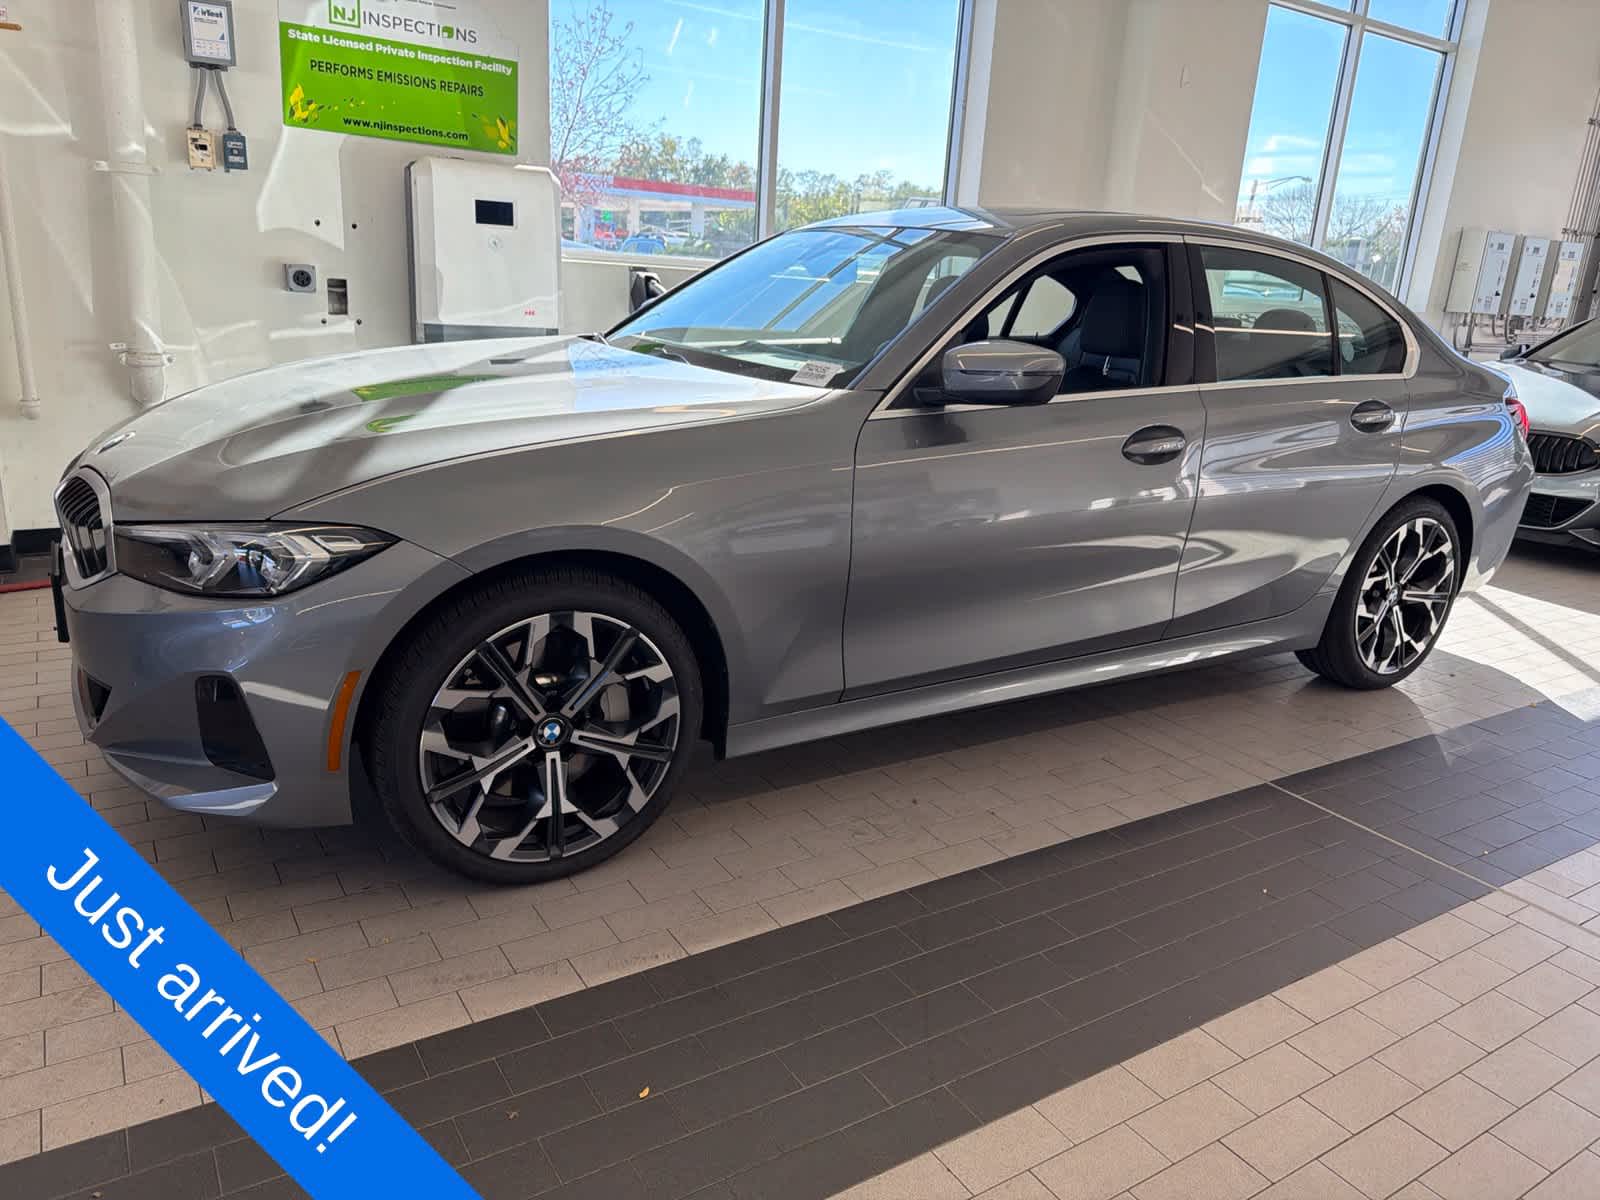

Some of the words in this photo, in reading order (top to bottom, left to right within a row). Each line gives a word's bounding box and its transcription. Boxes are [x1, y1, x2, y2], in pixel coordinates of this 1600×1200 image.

[333, 5, 356, 21] NJ
[363, 10, 477, 43] INSPECTIONS
[288, 28, 320, 43] State
[323, 34, 373, 52] Licensed
[375, 42, 415, 58] Private
[418, 50, 472, 69] Inspection
[475, 60, 512, 76] Facility
[310, 59, 373, 80] PERFORMS
[376, 70, 436, 90] EMISSIONS
[440, 80, 484, 97] REPAIRS
[343, 117, 468, 141] www.njinspections.com
